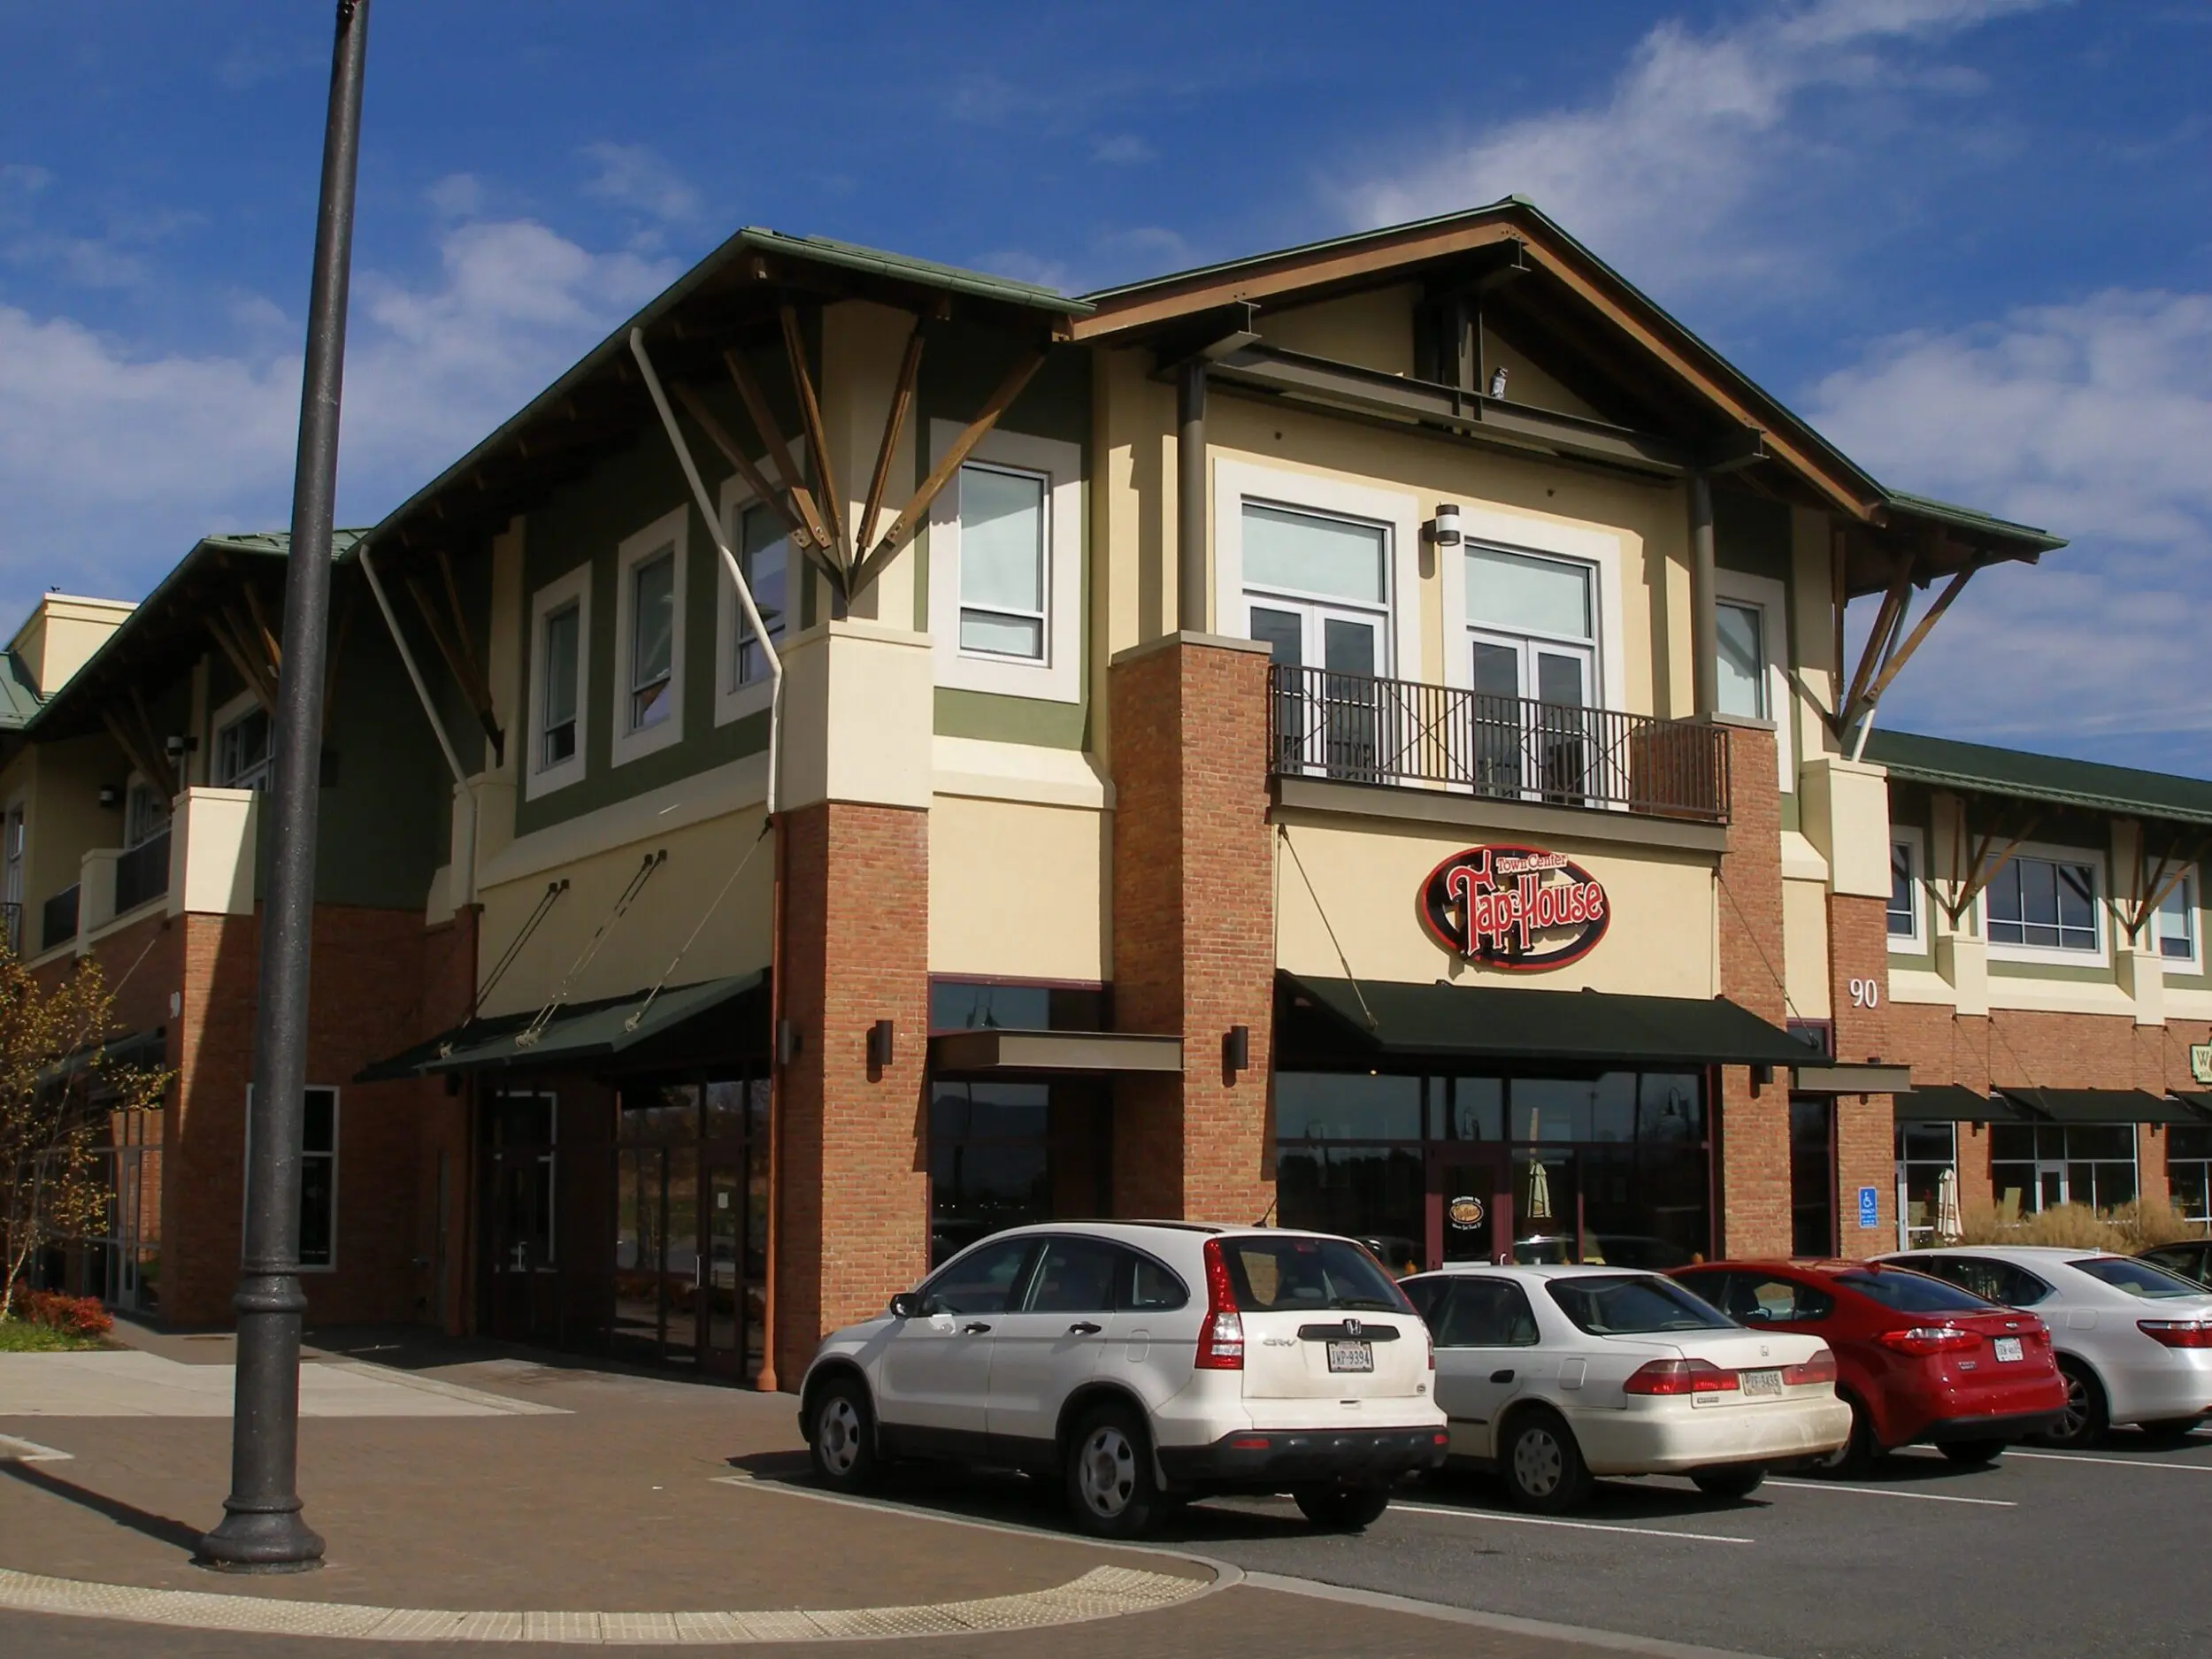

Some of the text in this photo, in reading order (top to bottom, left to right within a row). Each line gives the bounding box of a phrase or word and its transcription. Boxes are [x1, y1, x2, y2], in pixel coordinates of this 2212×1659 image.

[1497, 853, 1567, 873] Town Center
[1850, 978, 1878, 1008] 90
[2196, 1050, 2212, 1067] W
